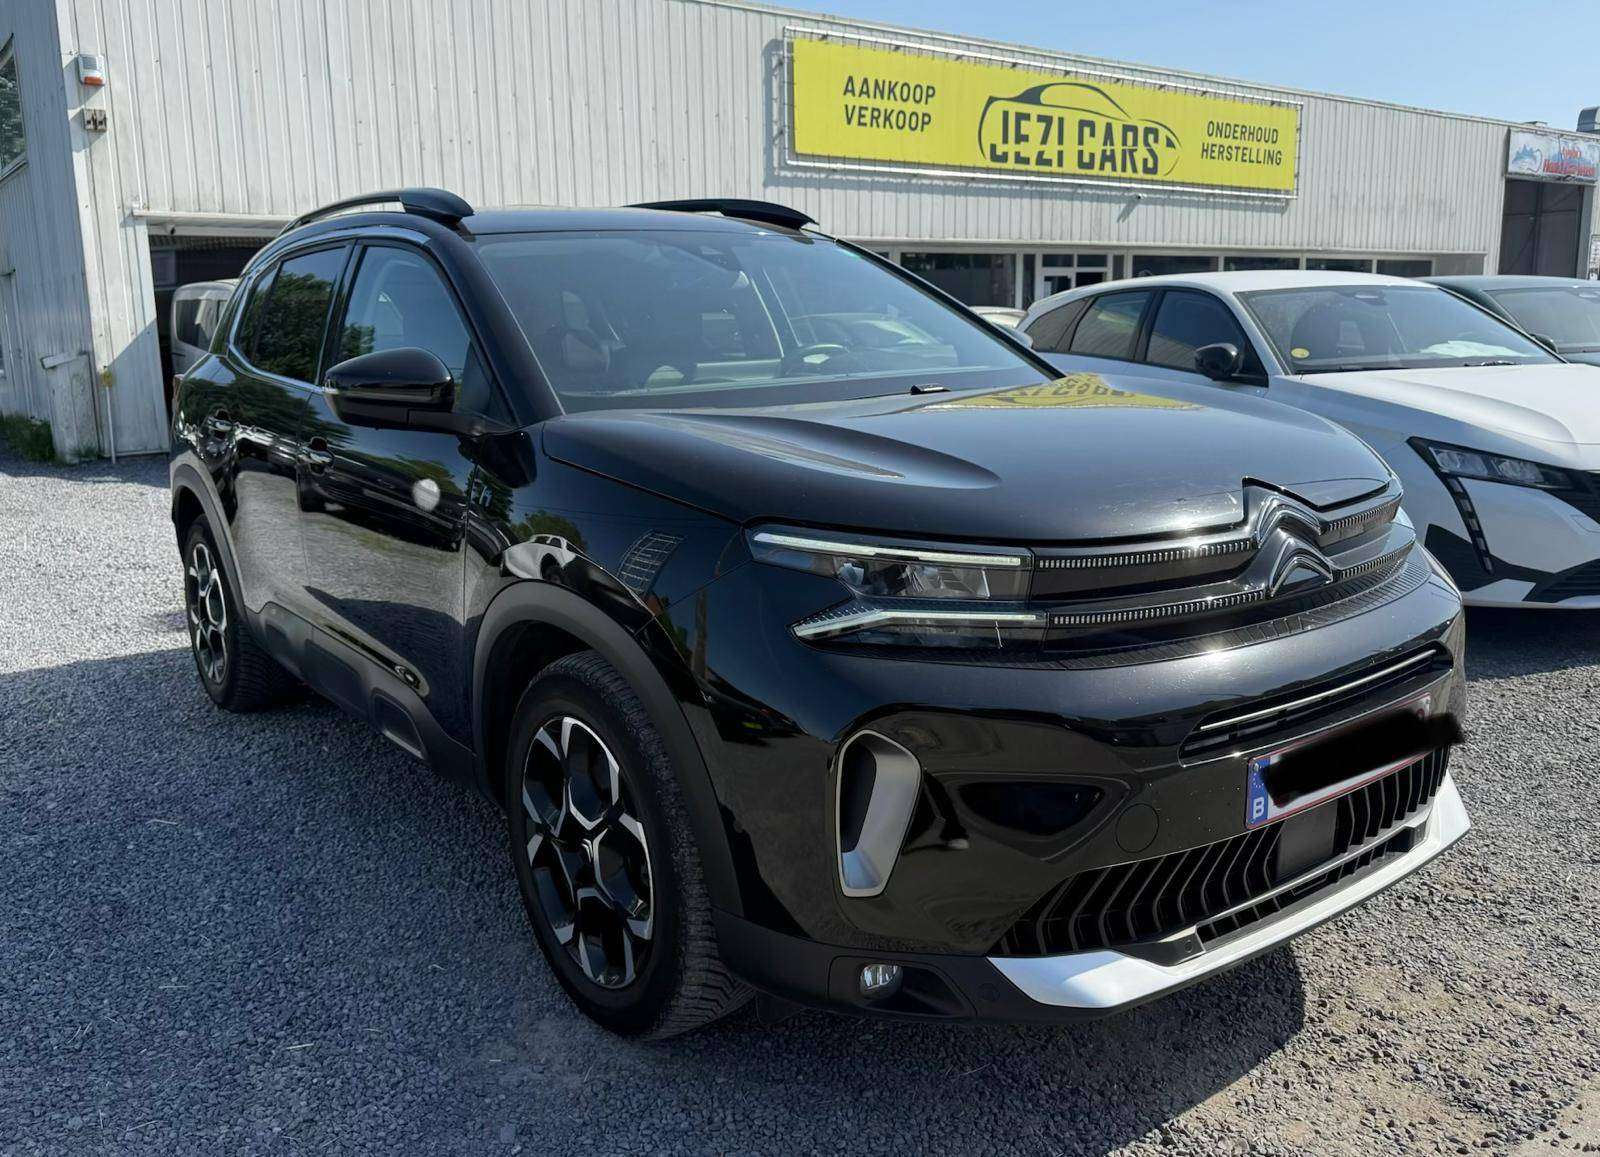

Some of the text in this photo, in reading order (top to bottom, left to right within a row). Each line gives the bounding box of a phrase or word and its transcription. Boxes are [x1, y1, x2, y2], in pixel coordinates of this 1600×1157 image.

[843, 76, 935, 104] AANKOOP
[845, 104, 931, 132] VERKOOP
[990, 110, 1159, 175] JEZI CARS
[1206, 121, 1278, 144] ONDERHOUD
[1201, 143, 1282, 166] HERSTELLING
[1253, 797, 1265, 818] B
